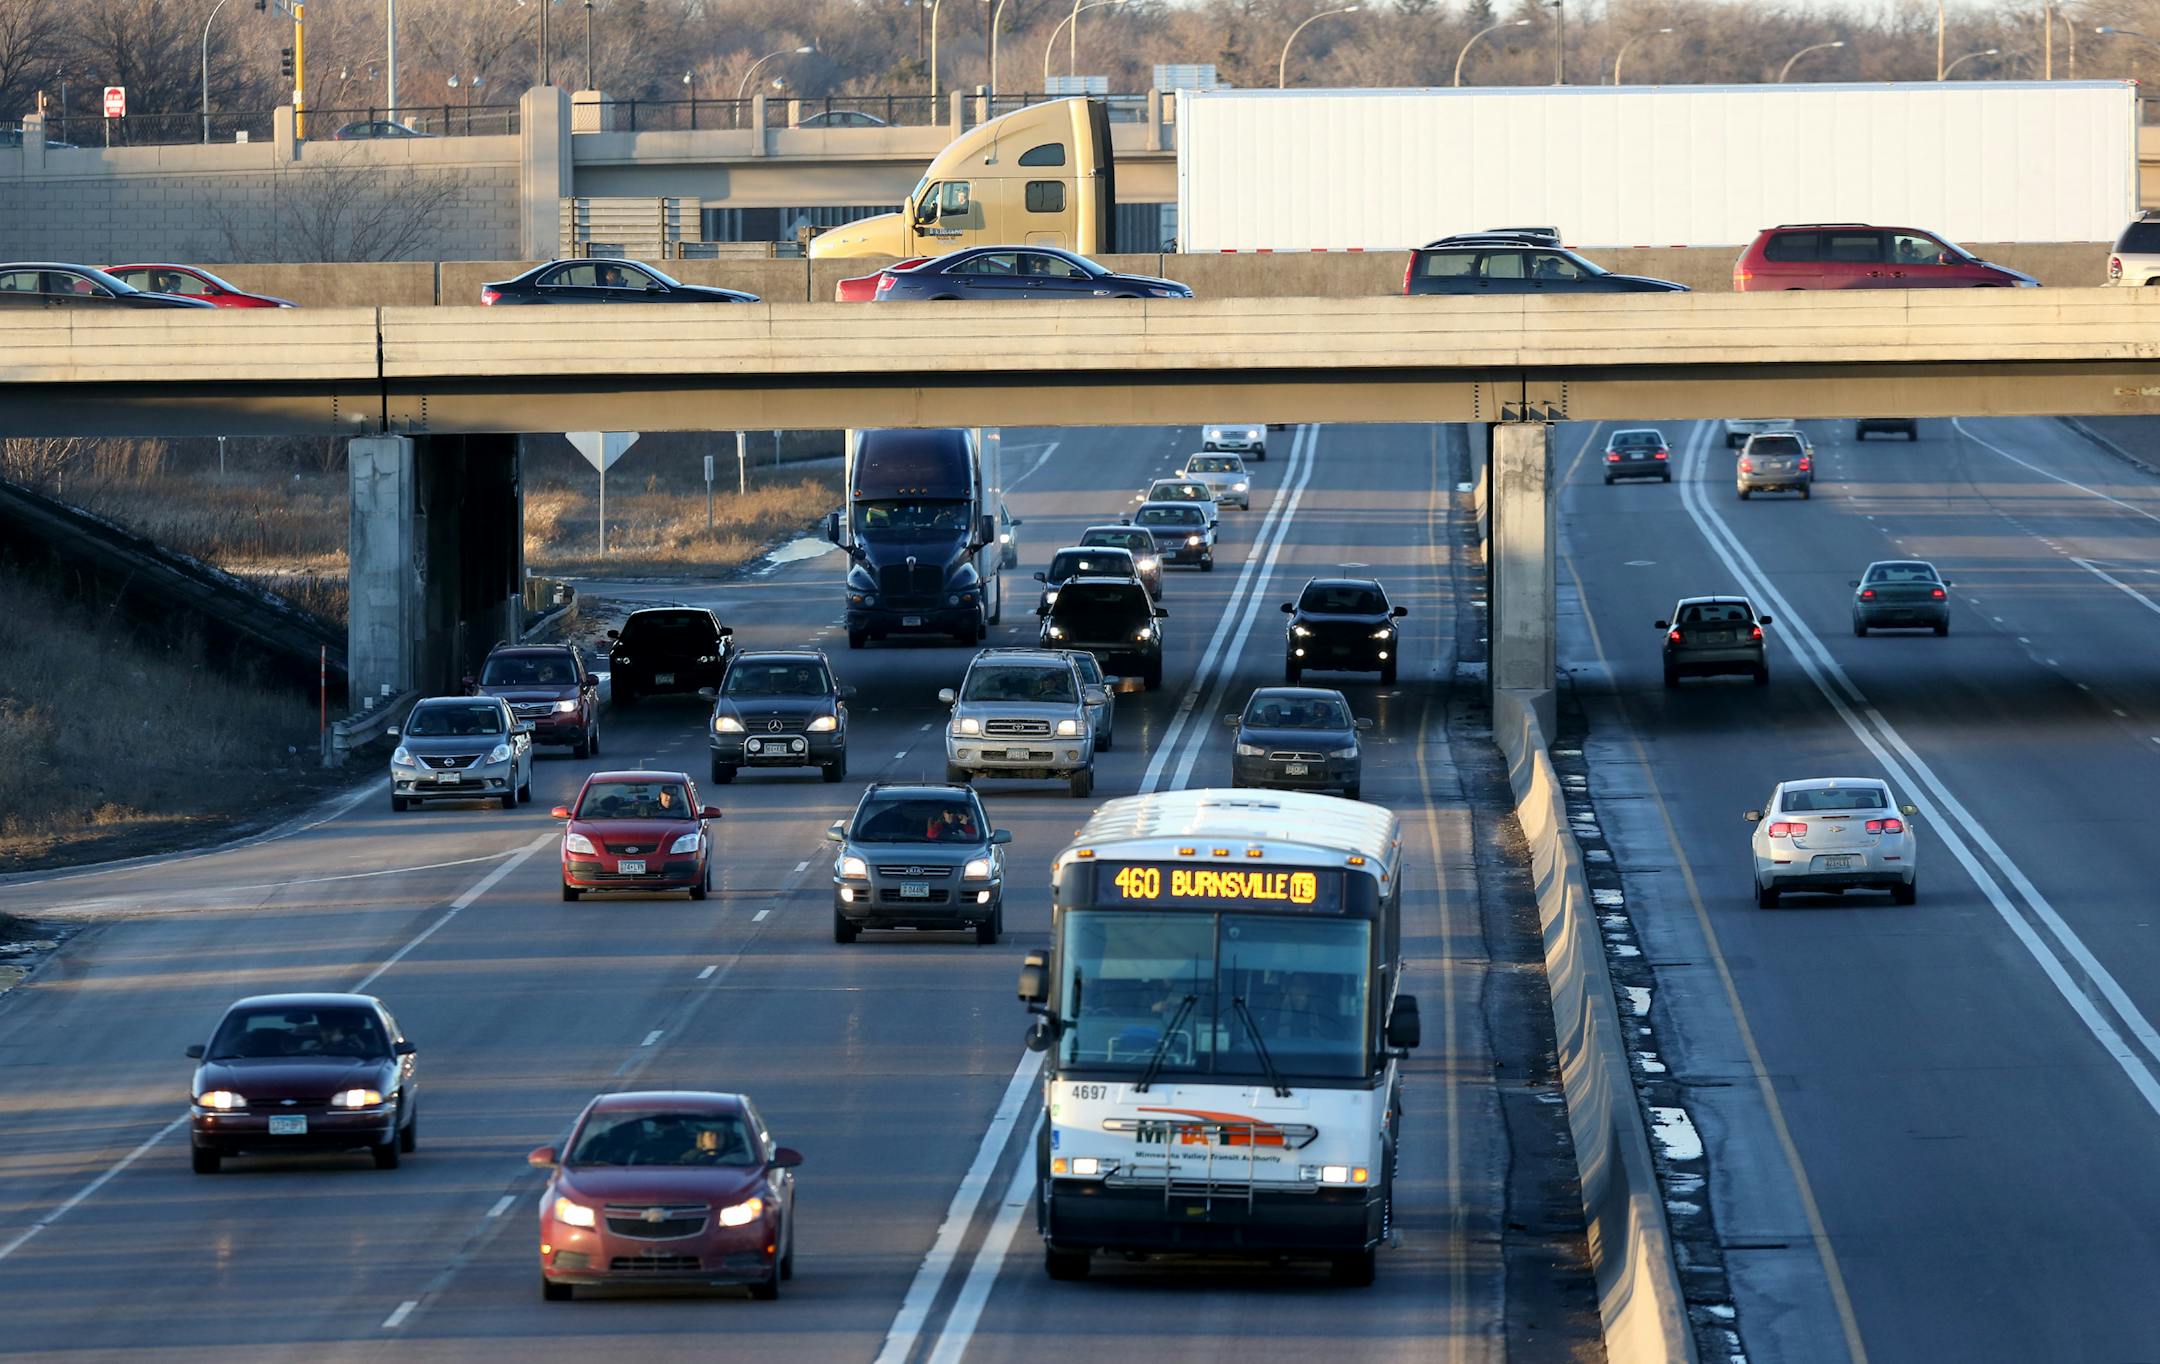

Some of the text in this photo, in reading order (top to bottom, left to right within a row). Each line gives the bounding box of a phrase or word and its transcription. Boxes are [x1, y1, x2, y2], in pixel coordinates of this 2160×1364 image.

[1114, 867, 1160, 899] 460
[1171, 869, 1288, 900] BURNSVILLE
[1072, 1085, 1107, 1100] 4697
[1182, 1152, 1207, 1161] Valley
